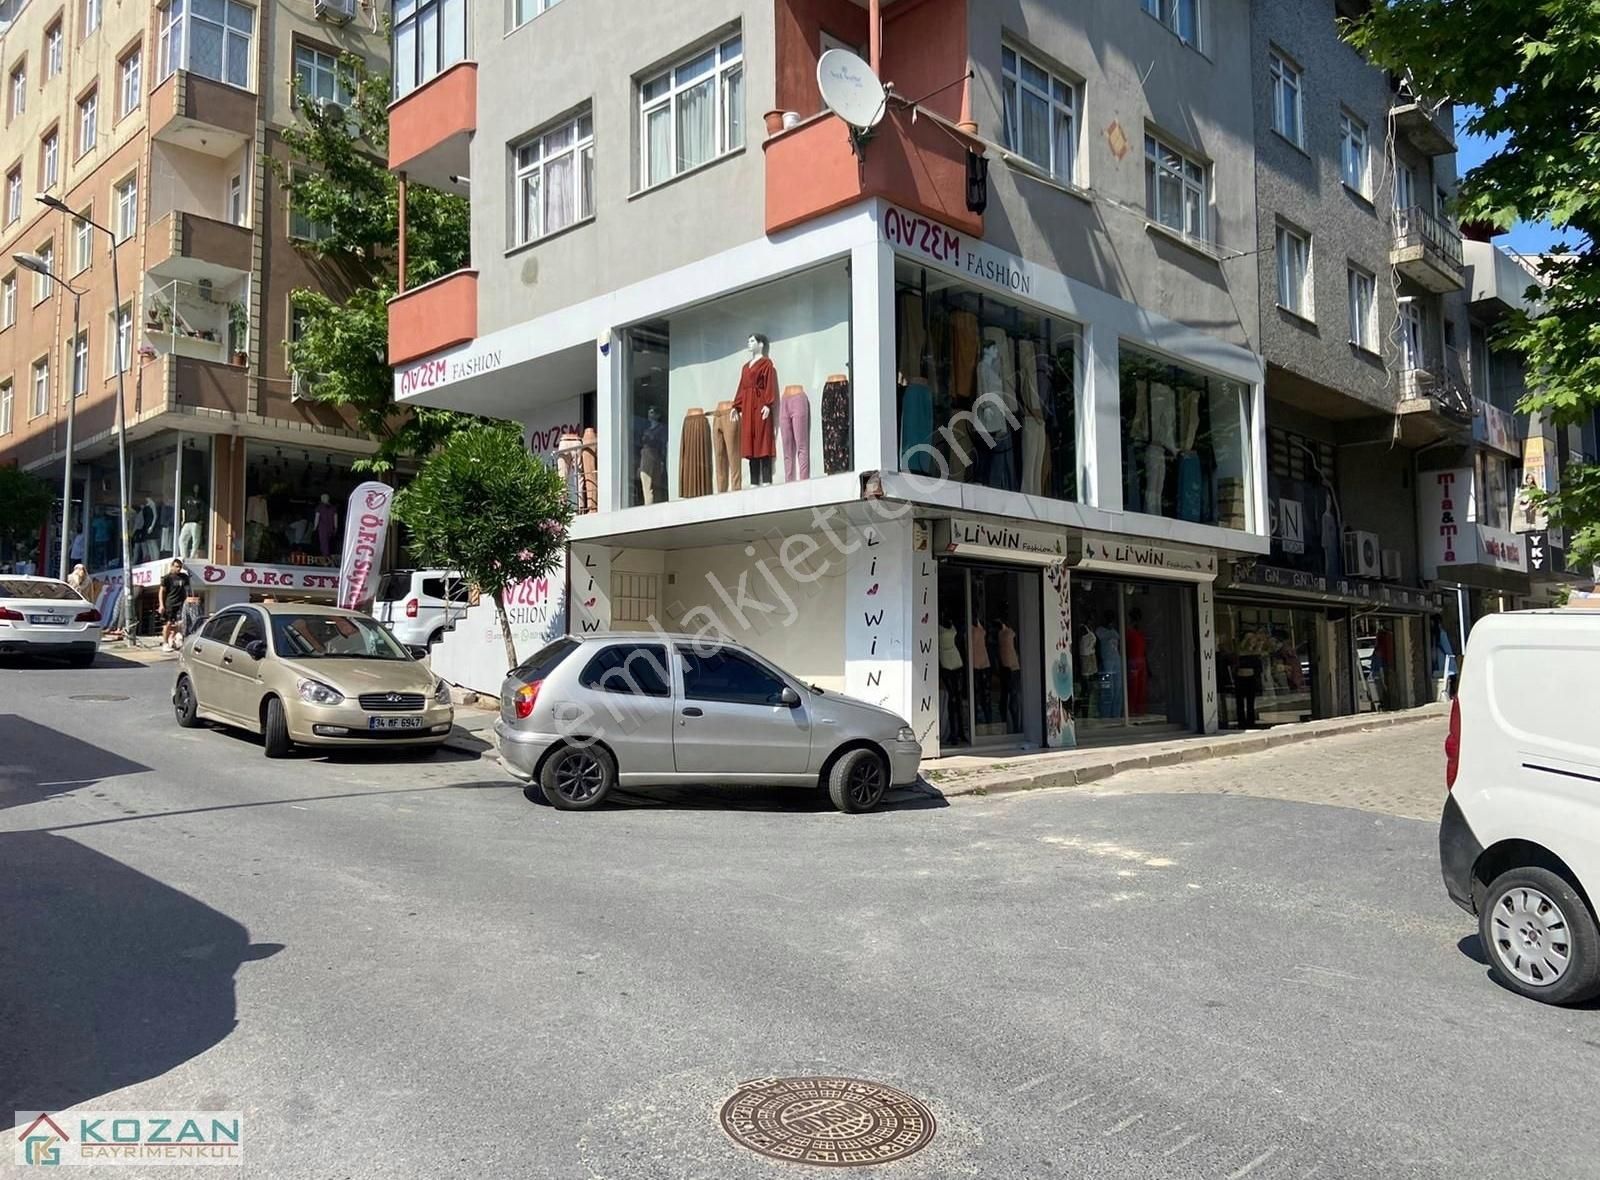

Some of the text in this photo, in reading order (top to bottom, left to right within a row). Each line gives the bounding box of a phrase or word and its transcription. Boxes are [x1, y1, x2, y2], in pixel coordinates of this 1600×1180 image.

[885, 208, 1030, 294] AVZEM FASHION
[401, 350, 503, 395] AVZEM FASHION
[1530, 535, 1543, 569] YKY
[303, 574, 340, 589] STY
[494, 606, 546, 625] FSHION
[375, 719, 385, 728] 34
[401, 718, 419, 728] 6947
